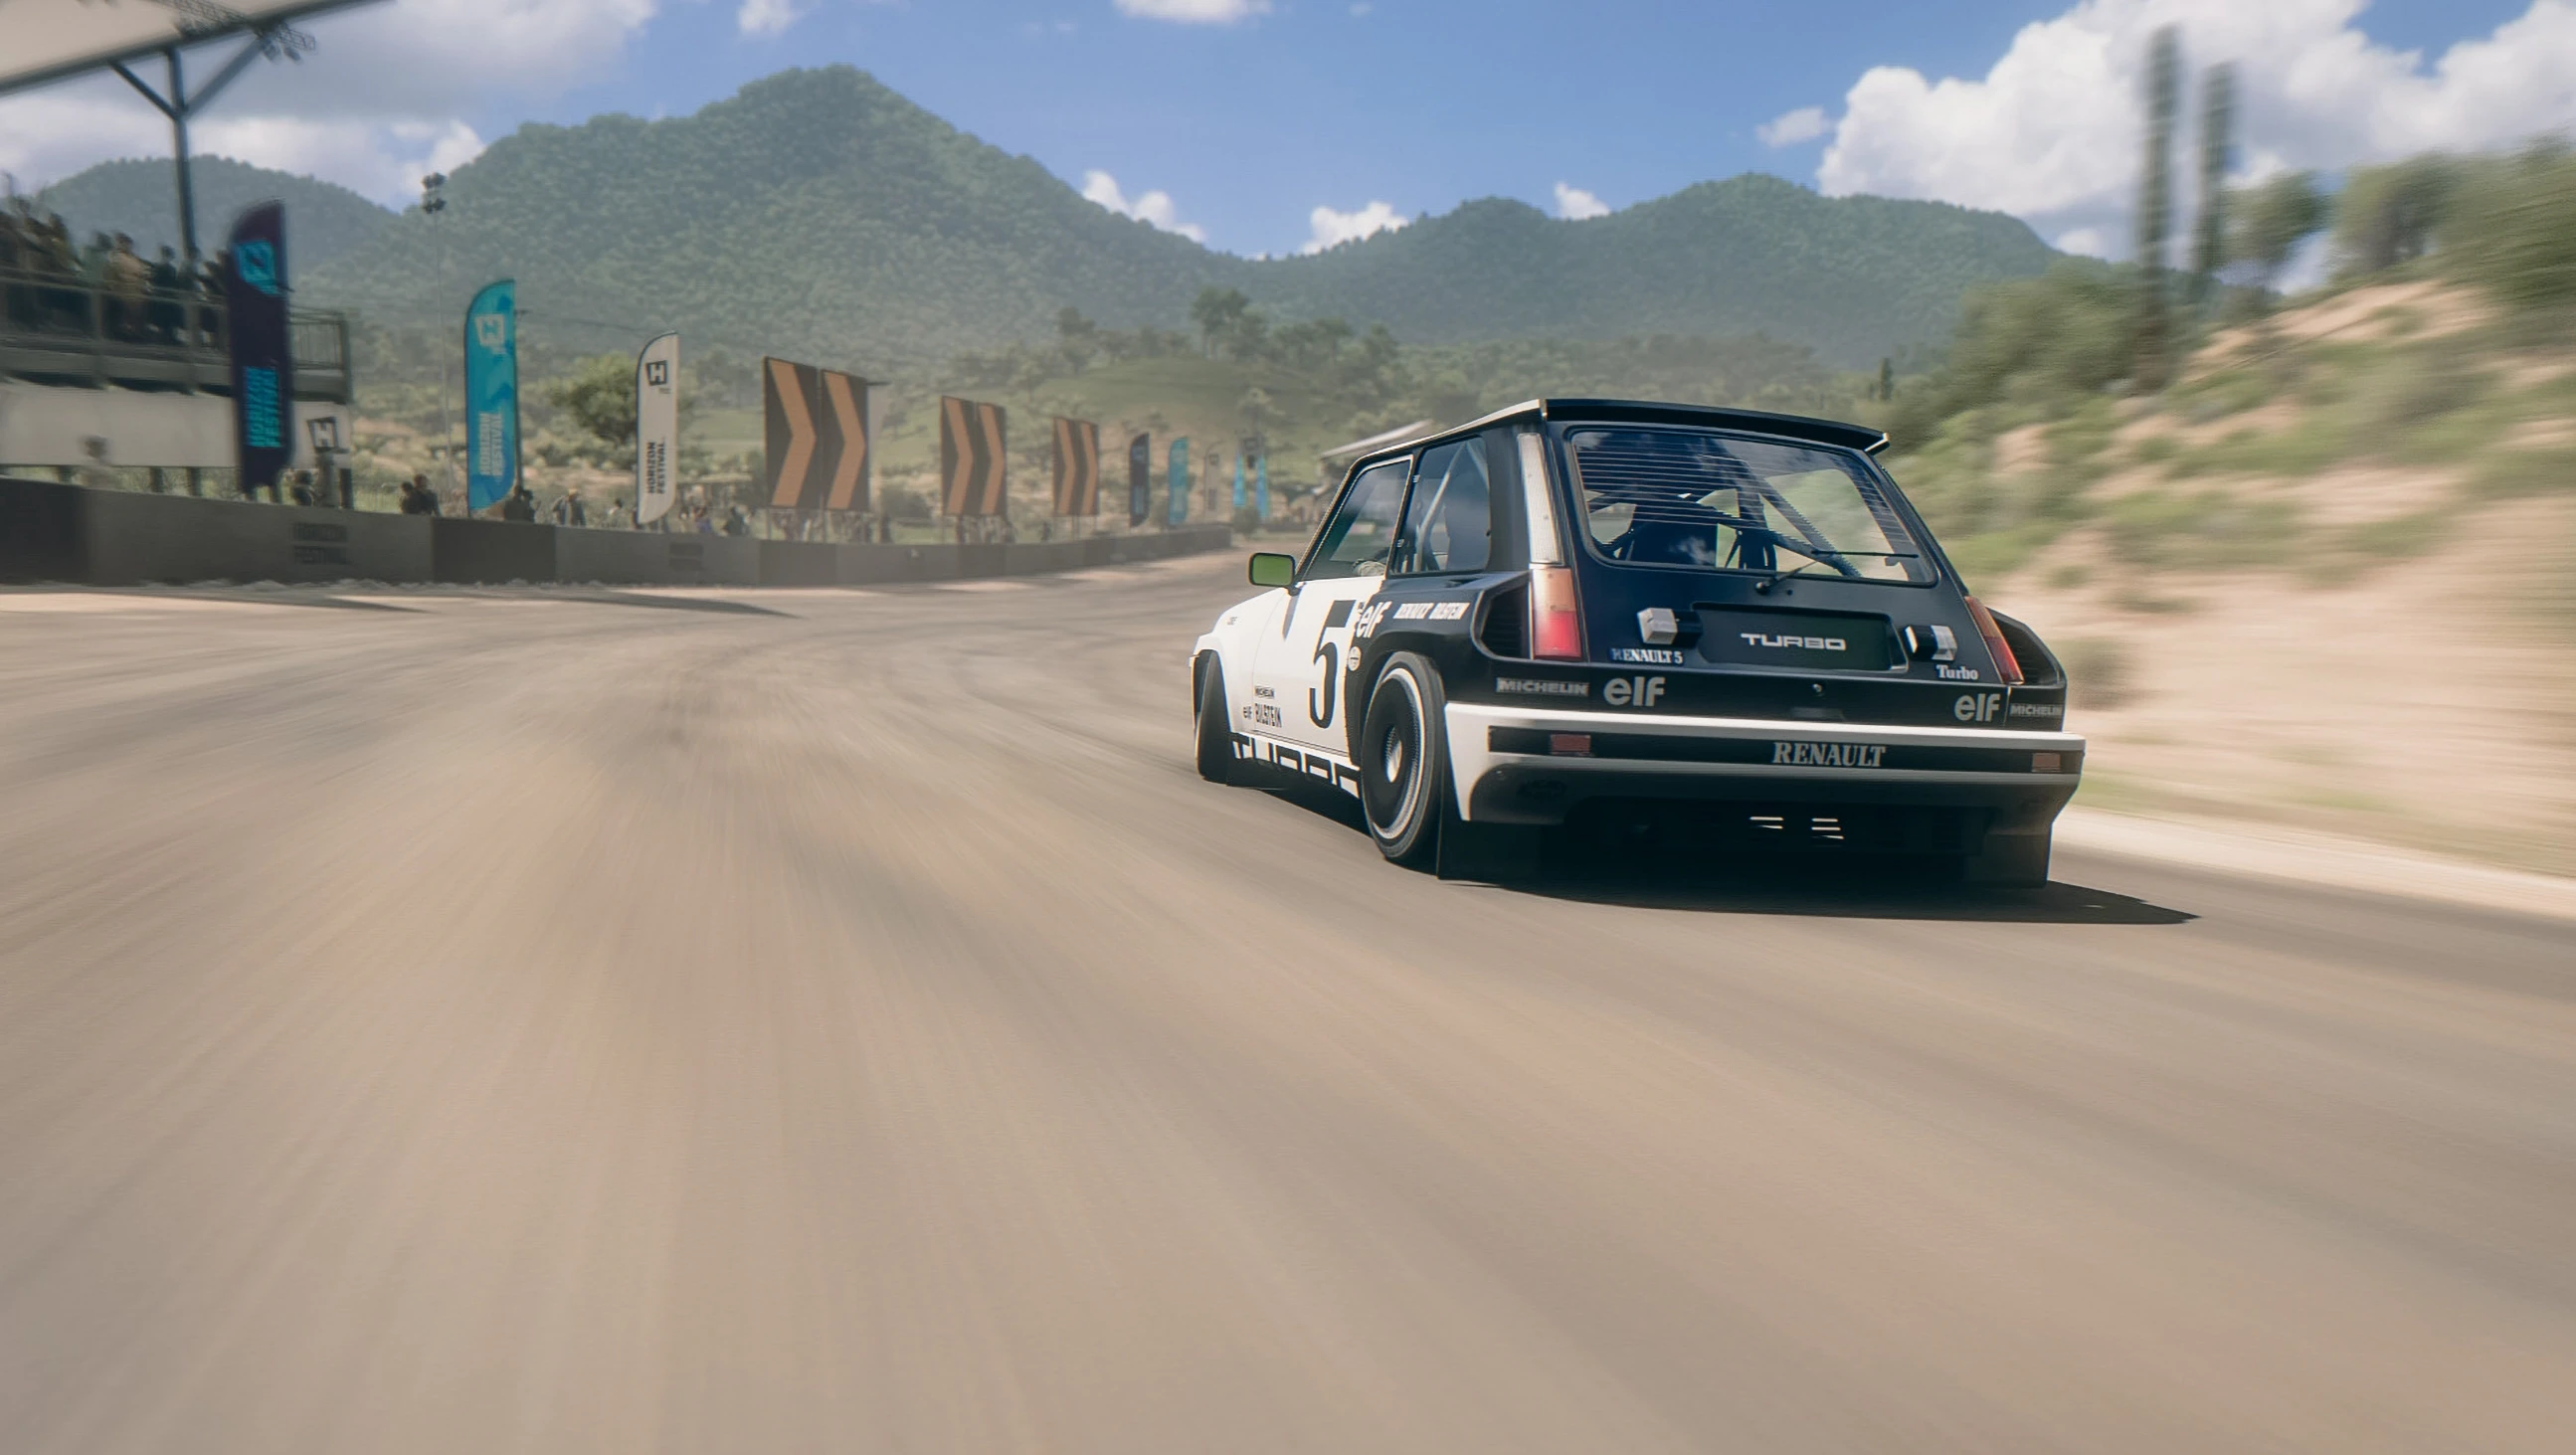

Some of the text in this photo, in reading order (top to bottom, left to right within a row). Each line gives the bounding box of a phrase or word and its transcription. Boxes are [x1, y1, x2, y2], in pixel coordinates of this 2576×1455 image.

[1356, 601, 1392, 637] elf
[1741, 633, 1847, 650] TURBO
[1309, 600, 1357, 729] 5
[1611, 647, 1684, 664] RENAULT 5
[1936, 664, 1979, 680] Turbo
[1496, 677, 1589, 695] MICHELIN
[1603, 676, 1666, 707] elf
[1954, 693, 2001, 721] elf
[2009, 704, 2064, 717] MICHELIN
[1771, 742, 1886, 767] RENAULT
